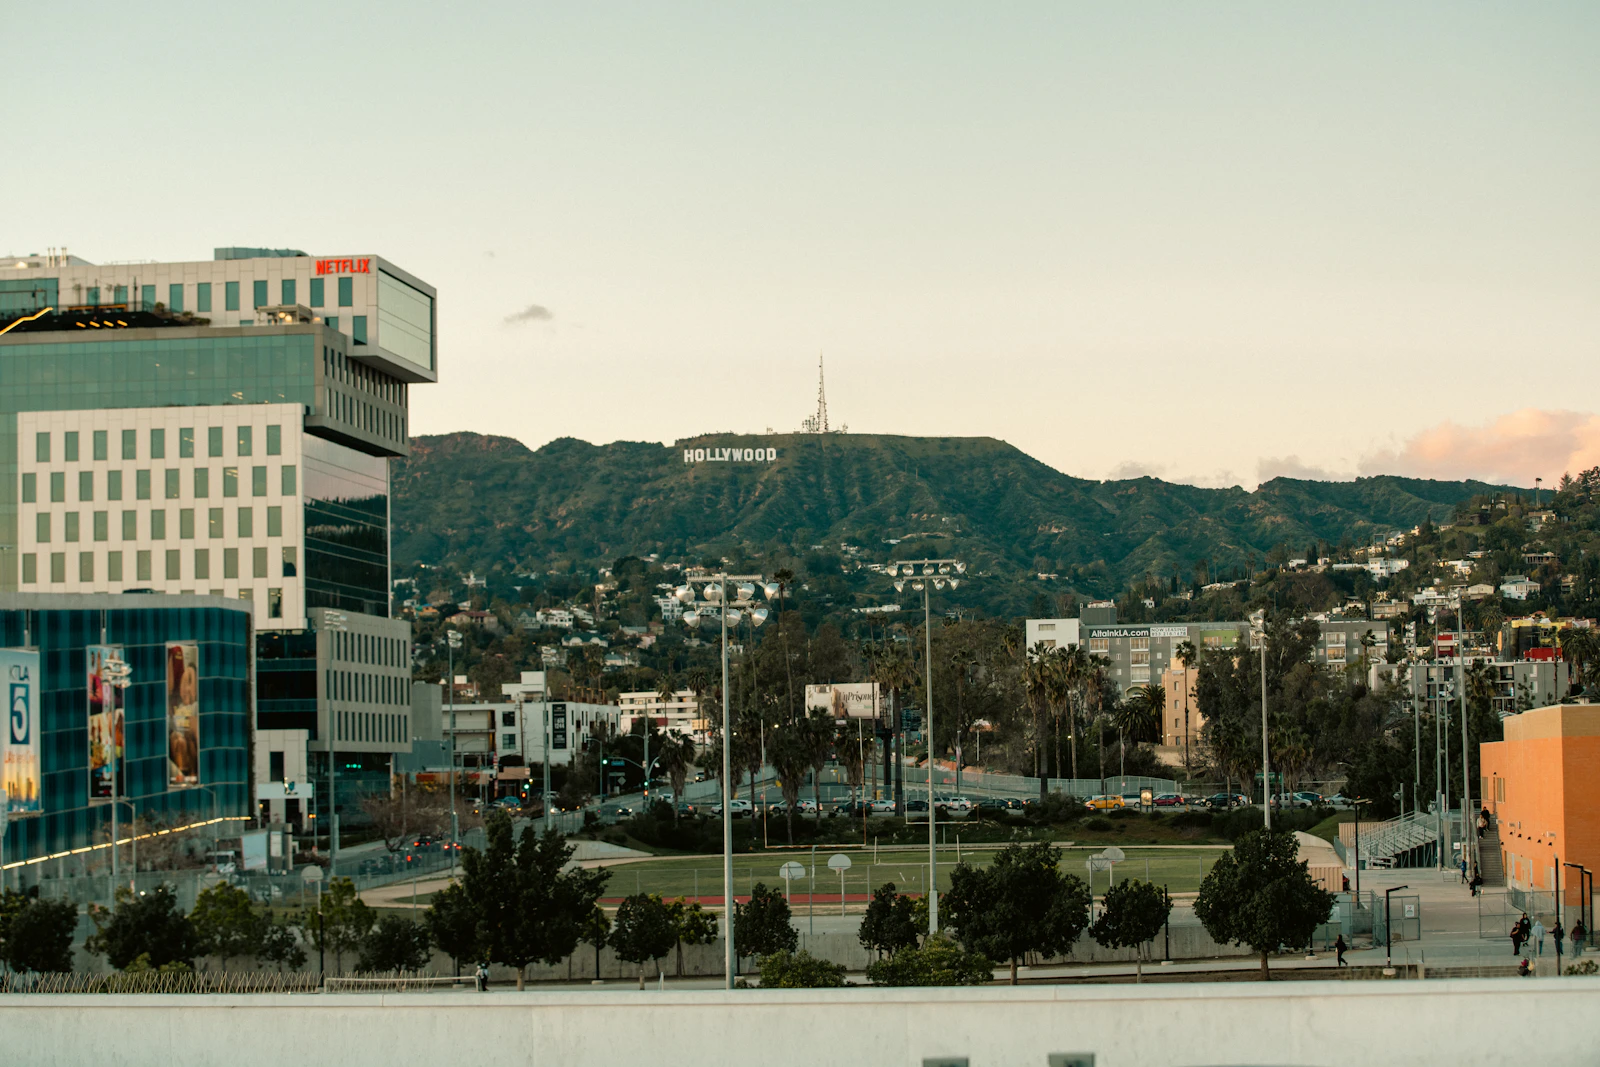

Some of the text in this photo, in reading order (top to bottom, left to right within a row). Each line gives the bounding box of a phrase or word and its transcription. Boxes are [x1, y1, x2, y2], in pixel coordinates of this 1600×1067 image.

[316, 258, 370, 276] NETFLIX
[684, 448, 776, 462] HOLLYWOOD
[12, 687, 27, 741] 5
